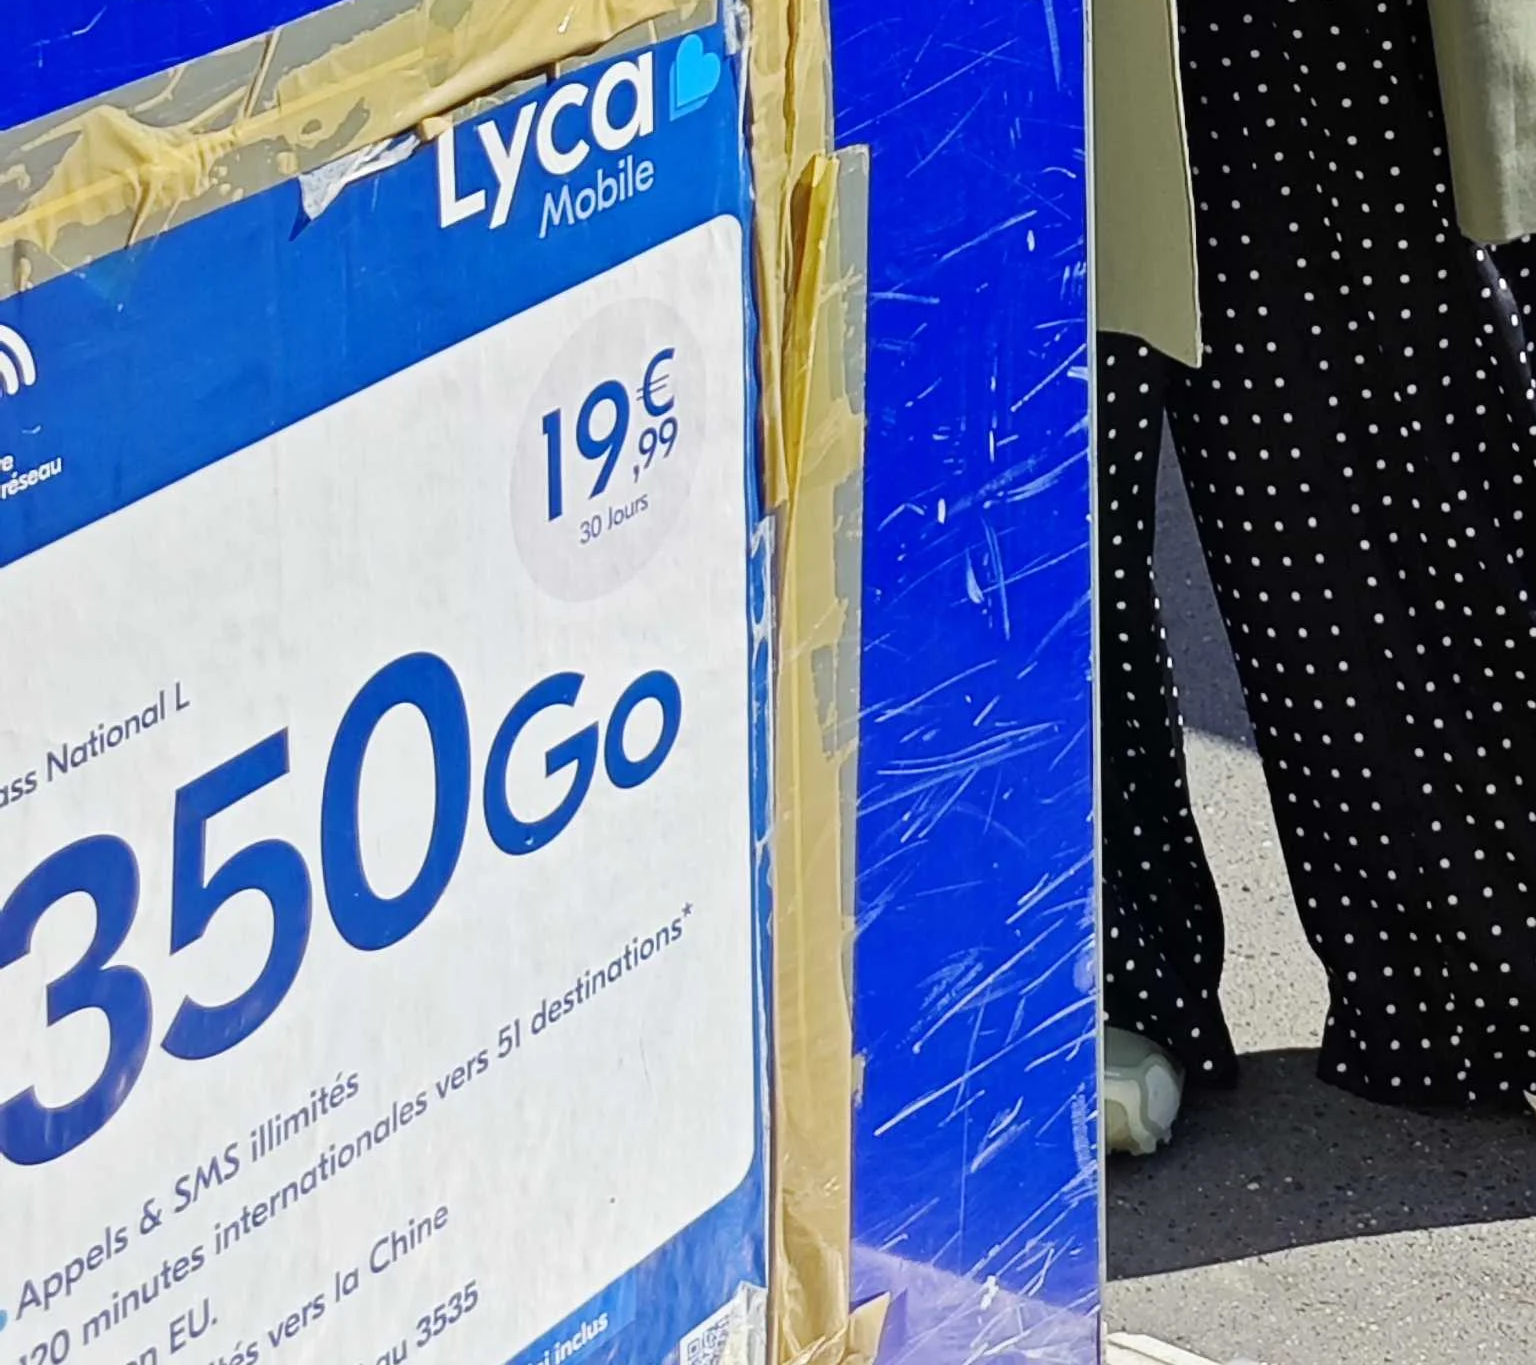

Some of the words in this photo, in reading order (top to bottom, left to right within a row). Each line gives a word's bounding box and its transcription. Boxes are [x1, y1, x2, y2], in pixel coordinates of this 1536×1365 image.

[436, 49, 655, 231] Lyca
[538, 154, 655, 239] Mobile
[1, 456, 62, 500] réseau
[579, 513, 603, 546] 30
[606, 494, 649, 532] Jours
[46, 690, 165, 783] National
[175, 681, 191, 712] L
[15, 1224, 129, 1321] Appels
[138, 1197, 163, 1236] &
[173, 1139, 240, 1215] SMS
[248, 1069, 361, 1164] illimités
[82, 1243, 206, 1347] minutes
[214, 1089, 428, 1255] internationales
[434, 1047, 490, 1102] vers
[496, 1017, 522, 1060] 51
[266, 1292, 327, 1349] vers
[333, 1267, 360, 1304] la
[368, 1204, 450, 1275] Chine
[414, 1278, 480, 1349] 3535
[168, 1297, 219, 1355] EU.
[553, 1311, 609, 1365] inclus
